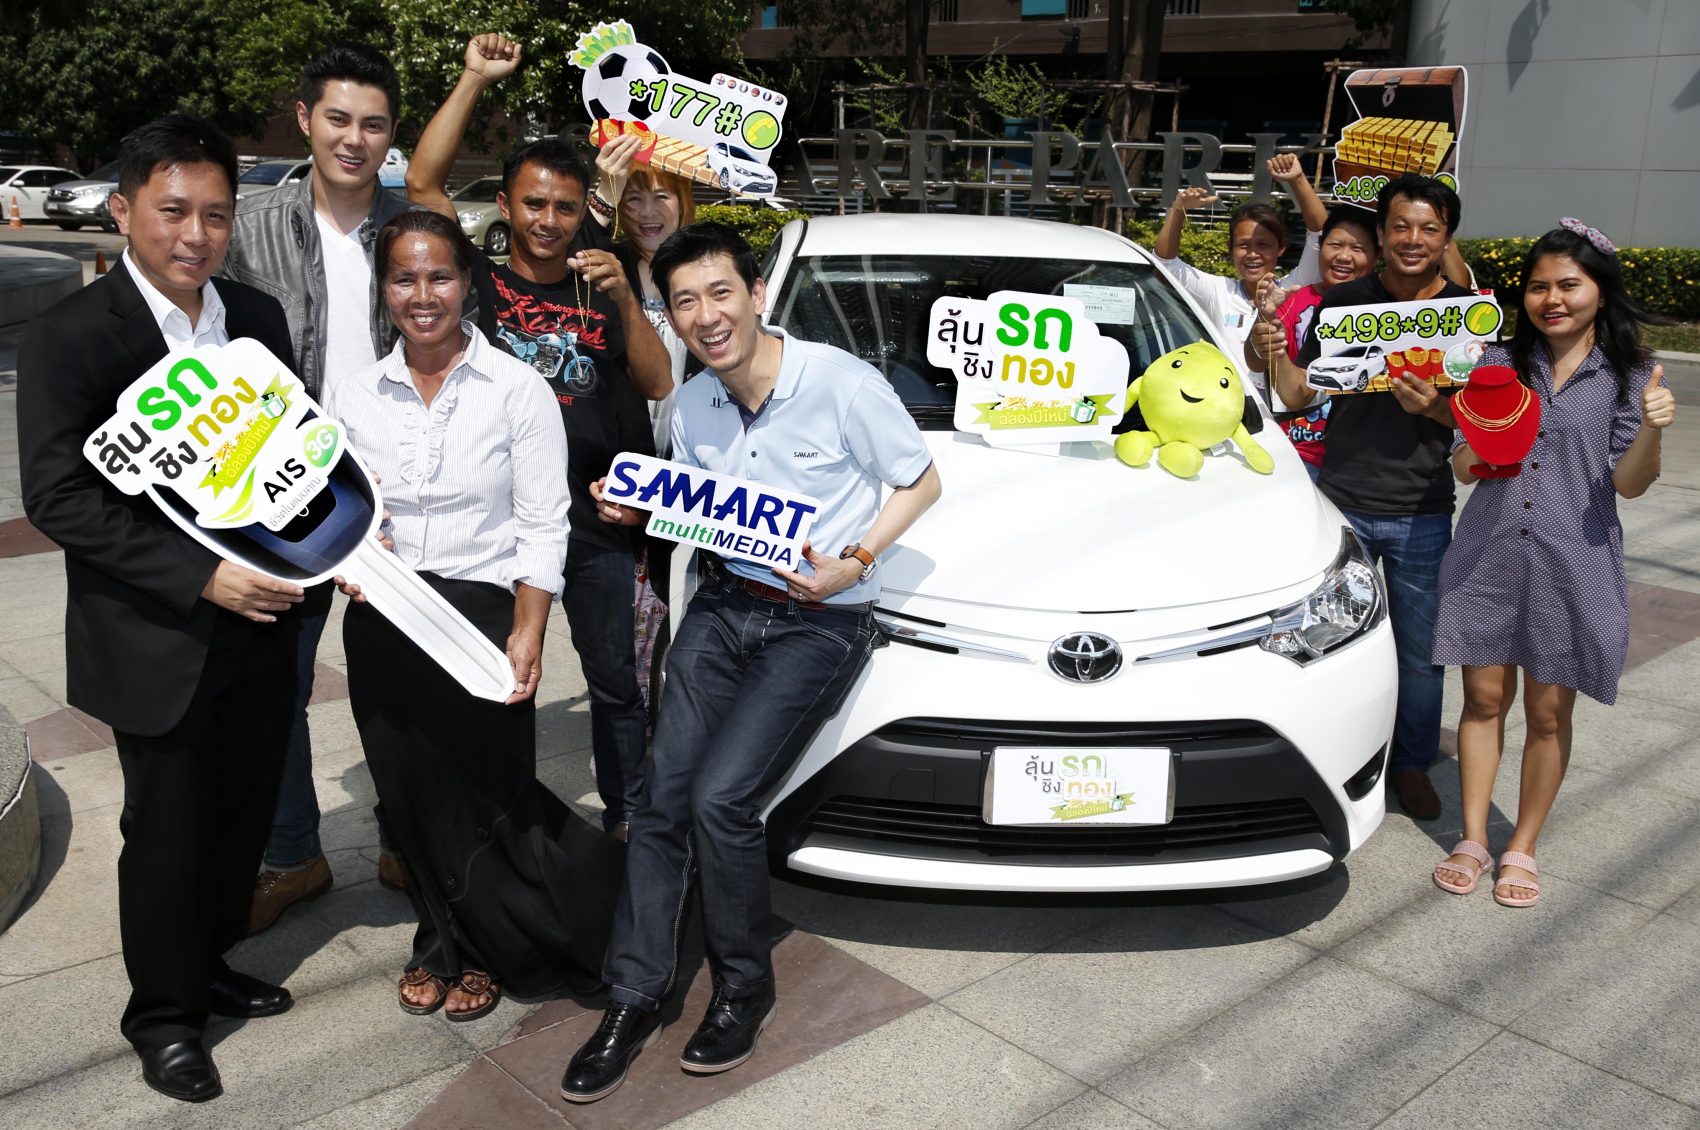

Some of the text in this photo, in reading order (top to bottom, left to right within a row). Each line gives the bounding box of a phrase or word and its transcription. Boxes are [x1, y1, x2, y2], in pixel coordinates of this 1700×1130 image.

[1023, 130, 1334, 213] PARK
[937, 302, 1073, 354] ลุ้น รถ
[963, 351, 1076, 389] ชิง ทอง
[92, 357, 219, 476] ลุ้น รถ
[149, 376, 258, 480] ชิง ทอง
[263, 428, 335, 504] AIS 3G
[652, 518, 793, 566] multiMEDIA
[1025, 754, 1102, 781] ลุ้น รถ
[1042, 778, 1112, 799] ชิง ทอง
